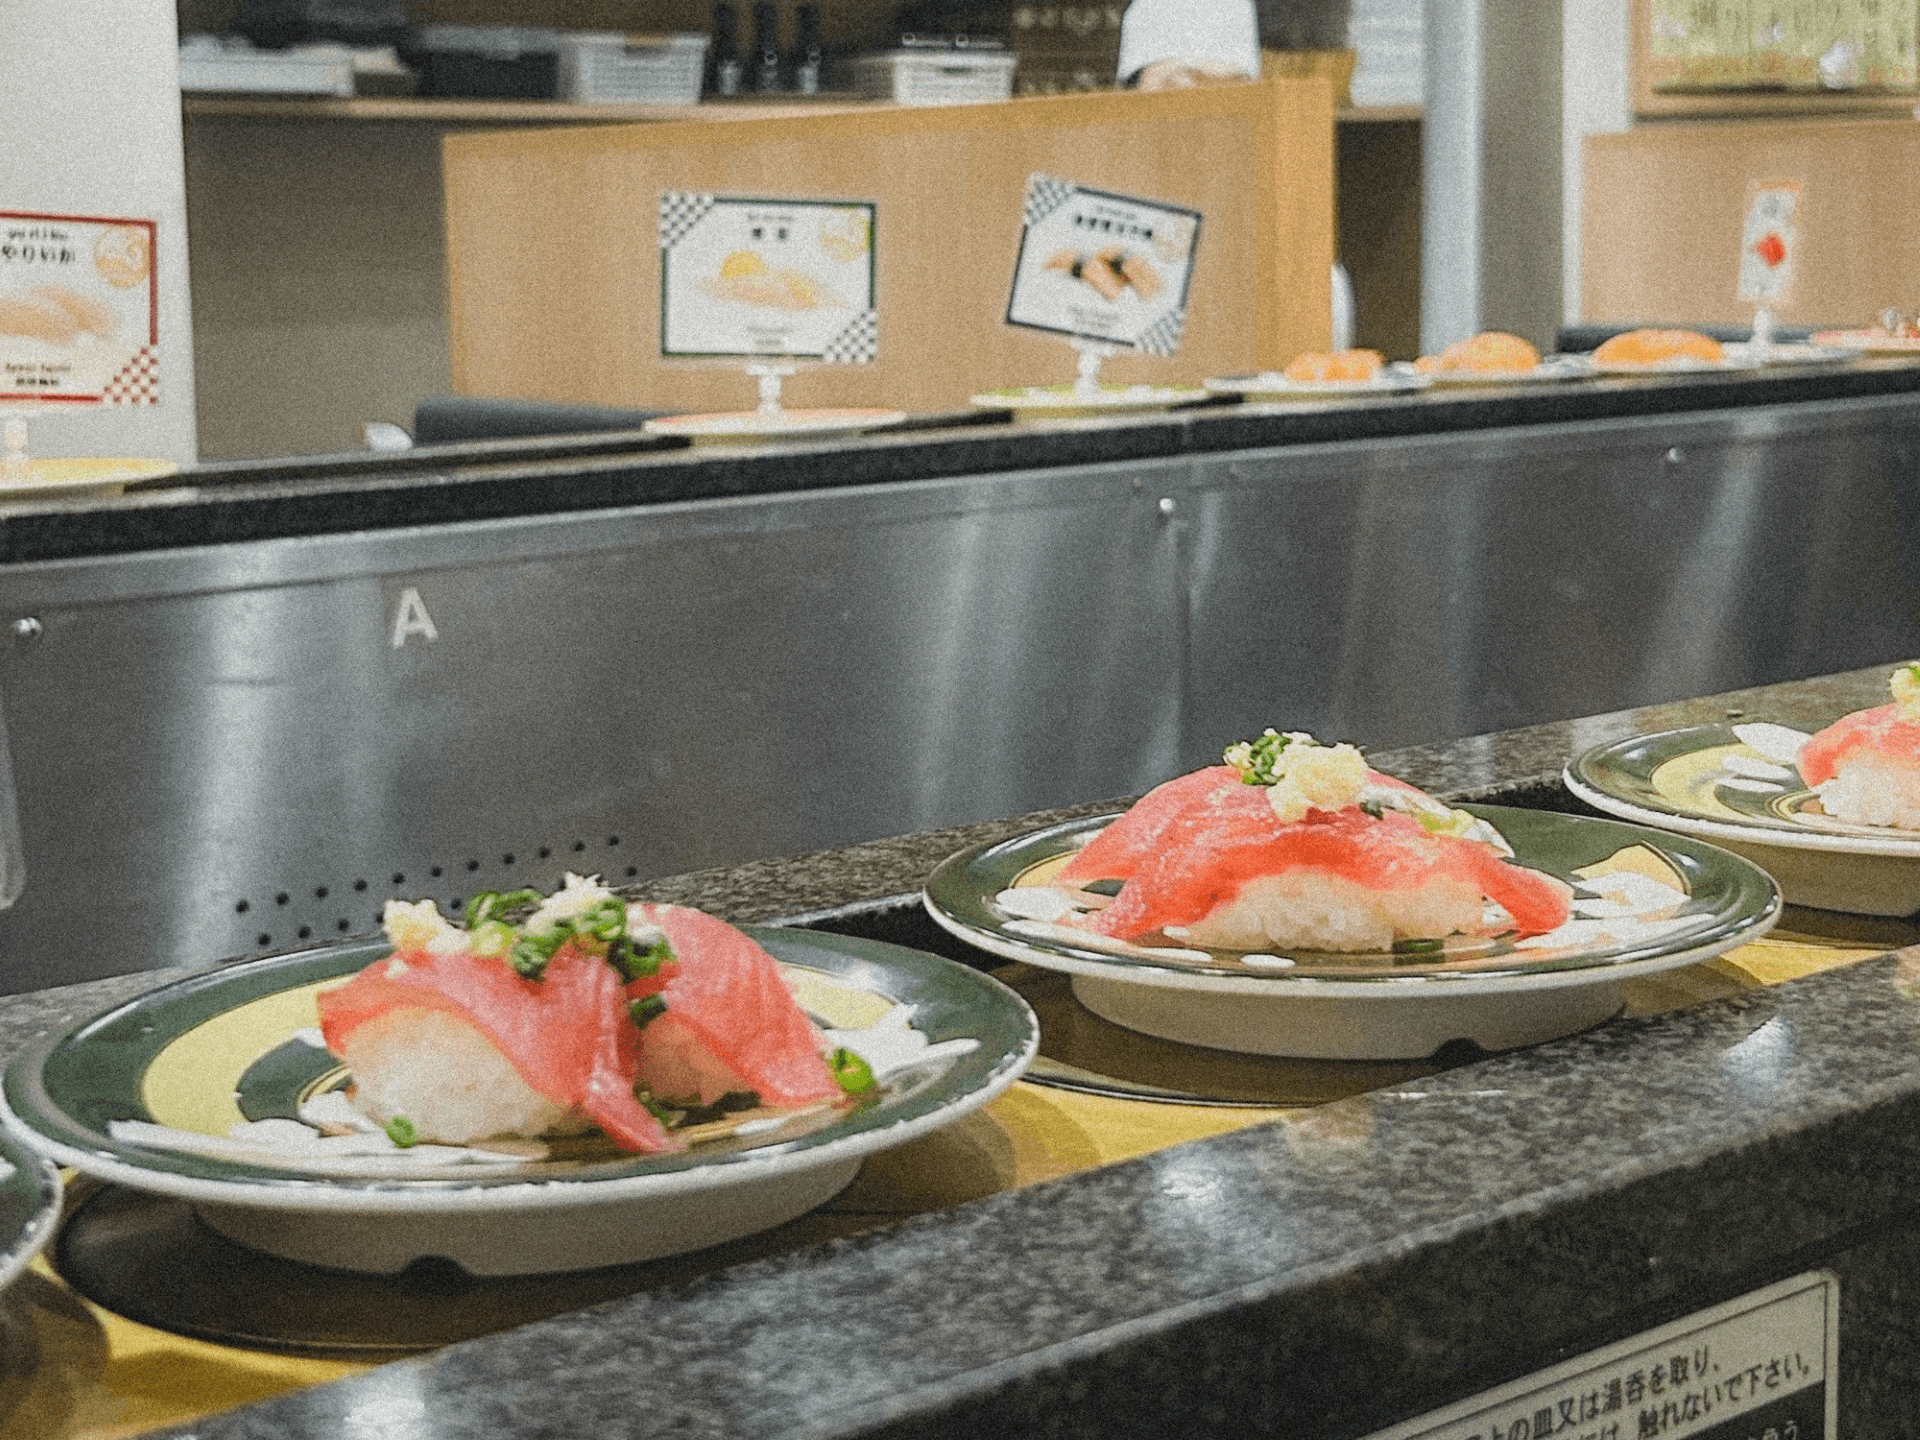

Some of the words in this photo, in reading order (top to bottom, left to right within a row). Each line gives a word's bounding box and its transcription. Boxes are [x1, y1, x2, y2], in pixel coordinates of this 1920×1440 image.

[391, 586, 439, 649] A
[1467, 1343, 1720, 1440] 上の皿又は湯呑を取り、
